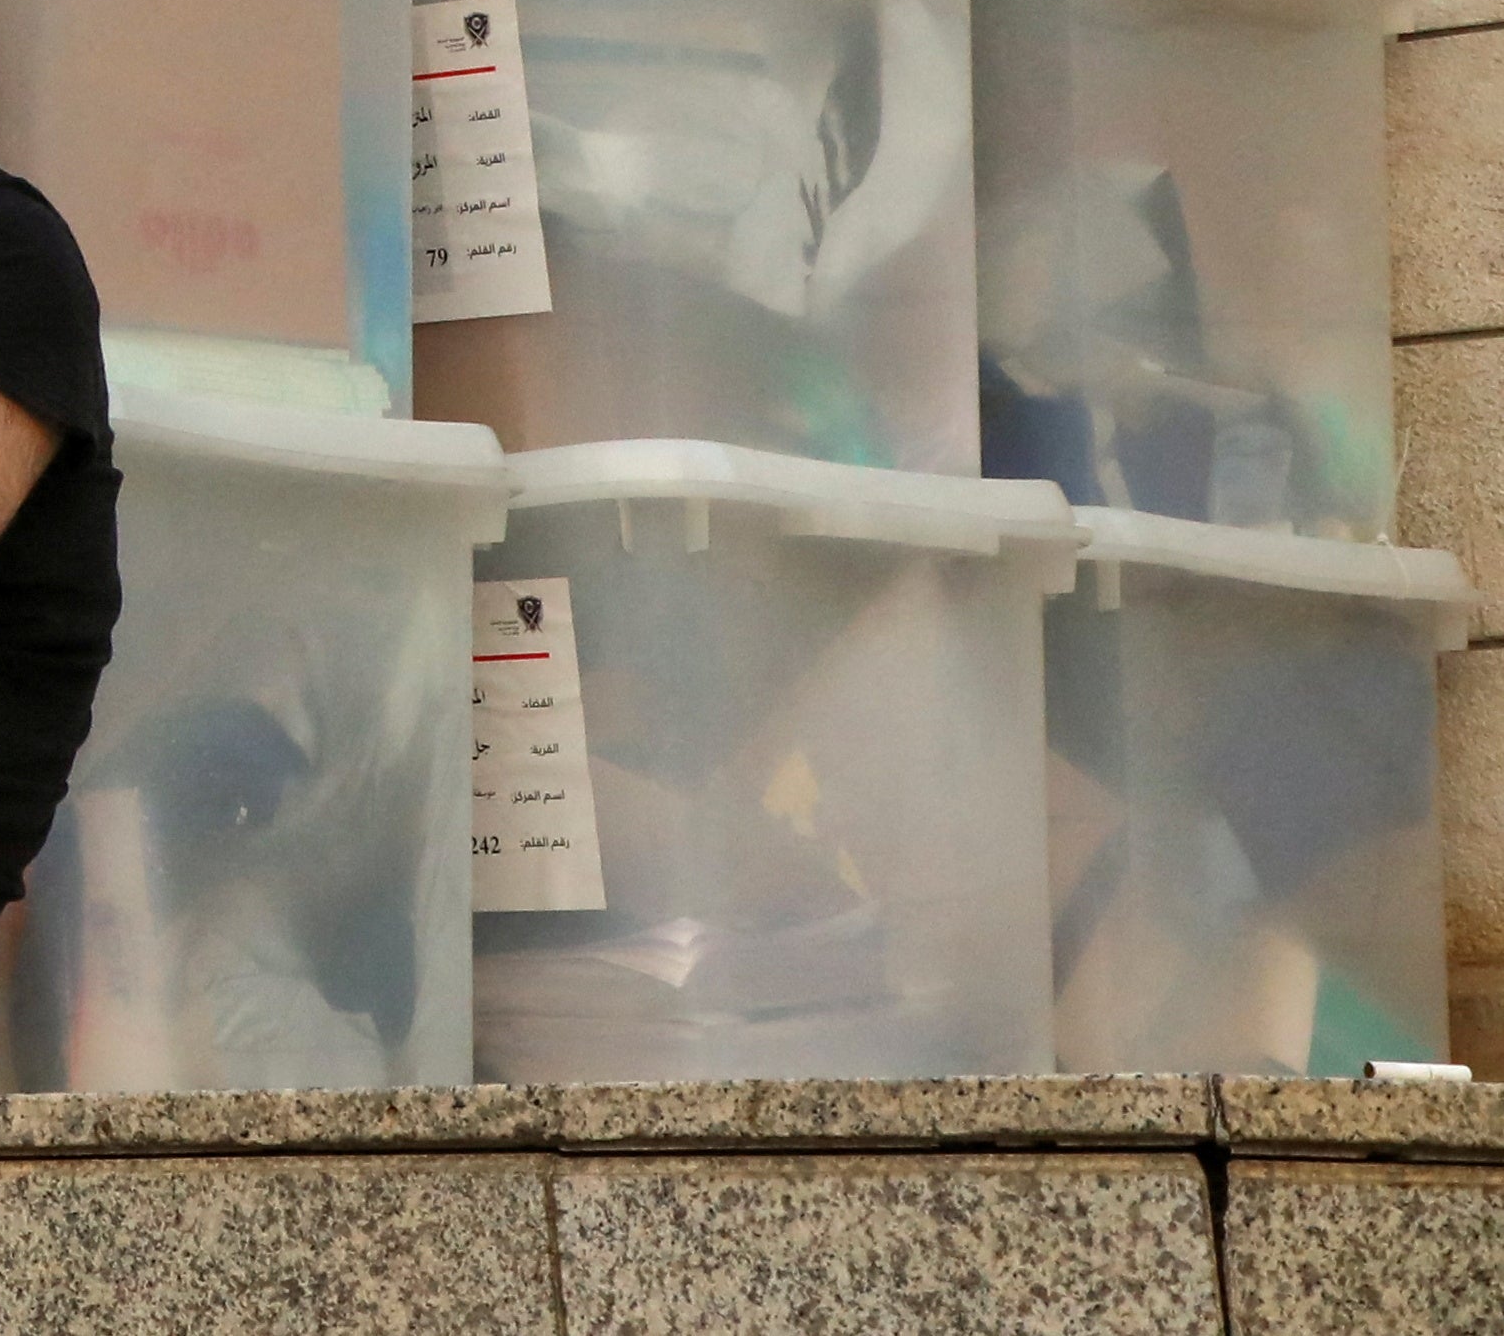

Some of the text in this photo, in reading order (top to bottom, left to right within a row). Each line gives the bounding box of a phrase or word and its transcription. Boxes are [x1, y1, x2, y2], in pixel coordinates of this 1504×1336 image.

[468, 108, 501, 122] القضاء:
[476, 153, 506, 167] القرية:
[457, 197, 511, 215] اسم المركز:
[426, 243, 517, 268] رقم القلم: 79
[522, 697, 554, 709] القضاء:
[511, 789, 566, 805] اسم المركز:
